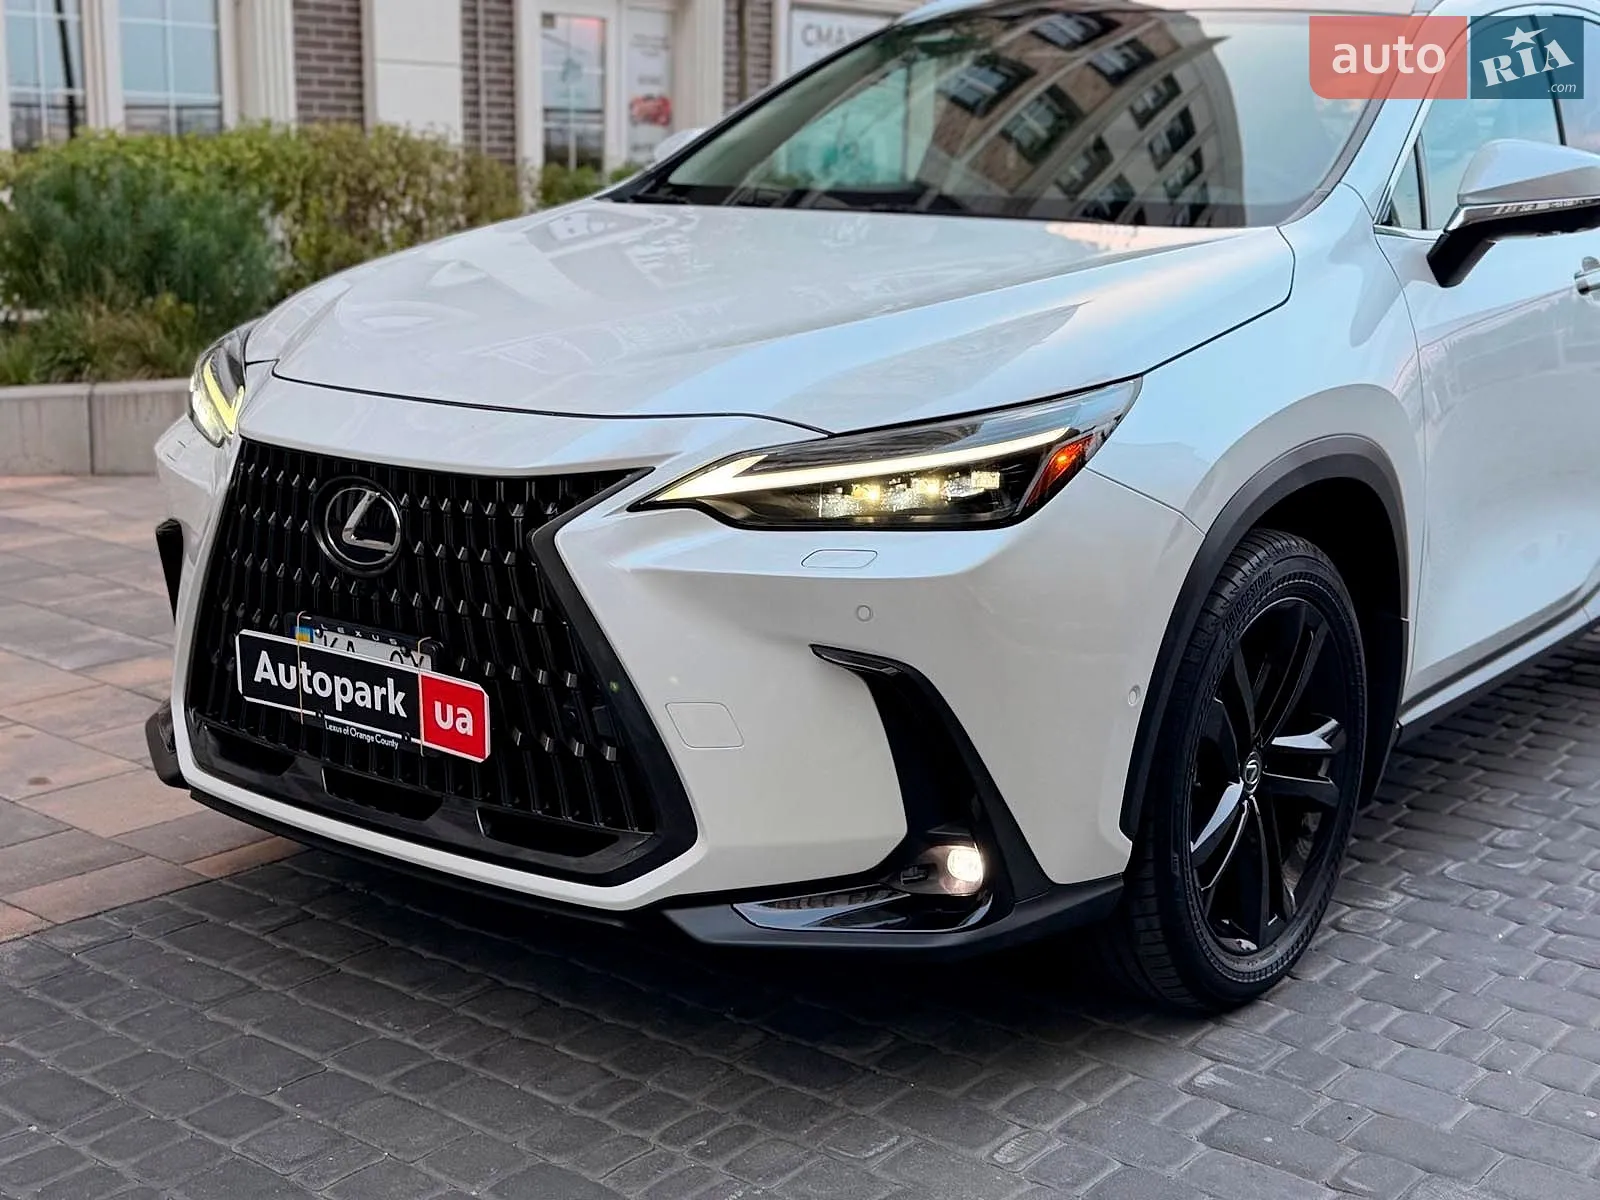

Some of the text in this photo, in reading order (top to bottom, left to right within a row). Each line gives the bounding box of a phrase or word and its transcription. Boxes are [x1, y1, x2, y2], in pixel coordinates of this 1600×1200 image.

[253, 649, 474, 737] Autopark ua
[325, 720, 399, 750] Lexus of Orange County
